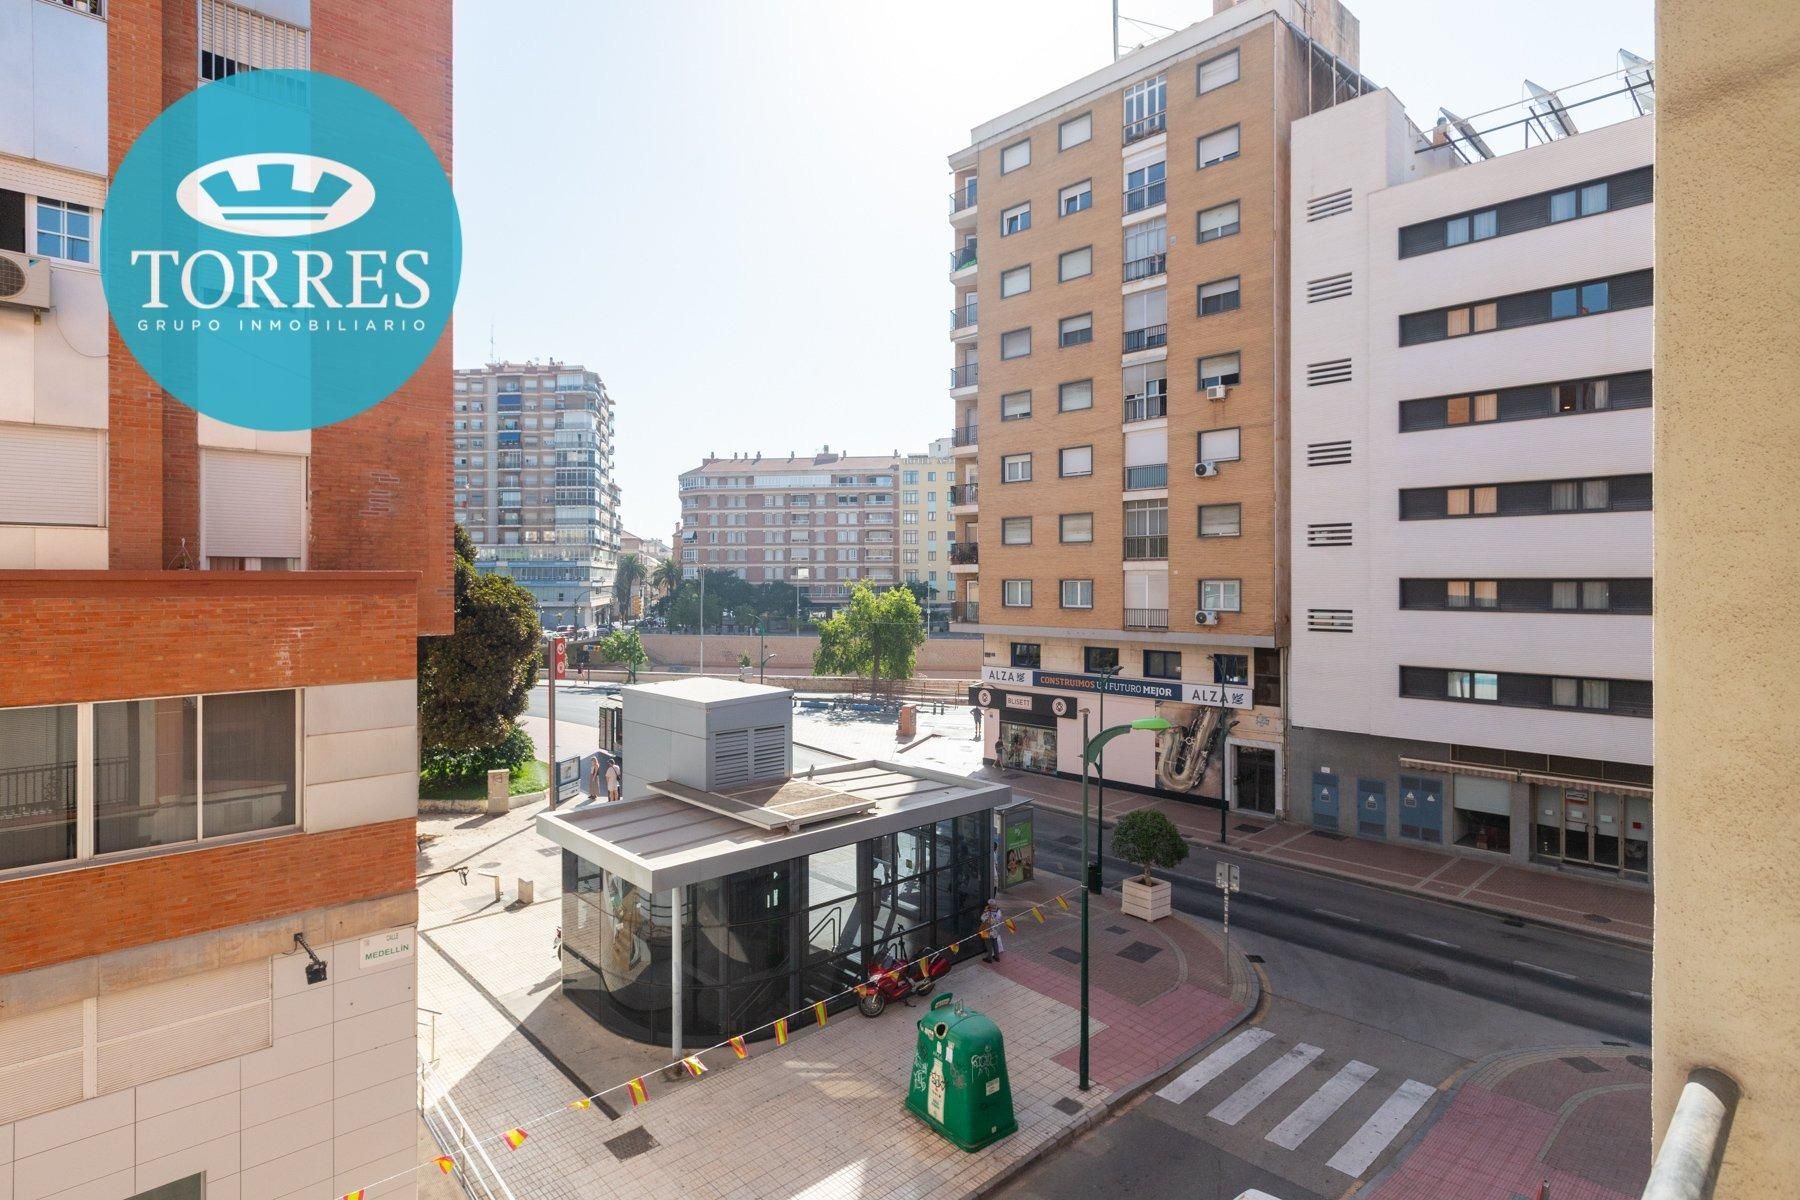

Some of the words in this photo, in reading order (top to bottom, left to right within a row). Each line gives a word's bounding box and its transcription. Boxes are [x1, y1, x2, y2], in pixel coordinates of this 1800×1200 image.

[989, 670, 1015, 682] ALZA
[1040, 676, 1095, 689] CONSTRUIMOS
[1109, 682, 1141, 694] FUTURO
[1142, 685, 1172, 697] MEJOR
[1192, 689, 1229, 704] ALZA
